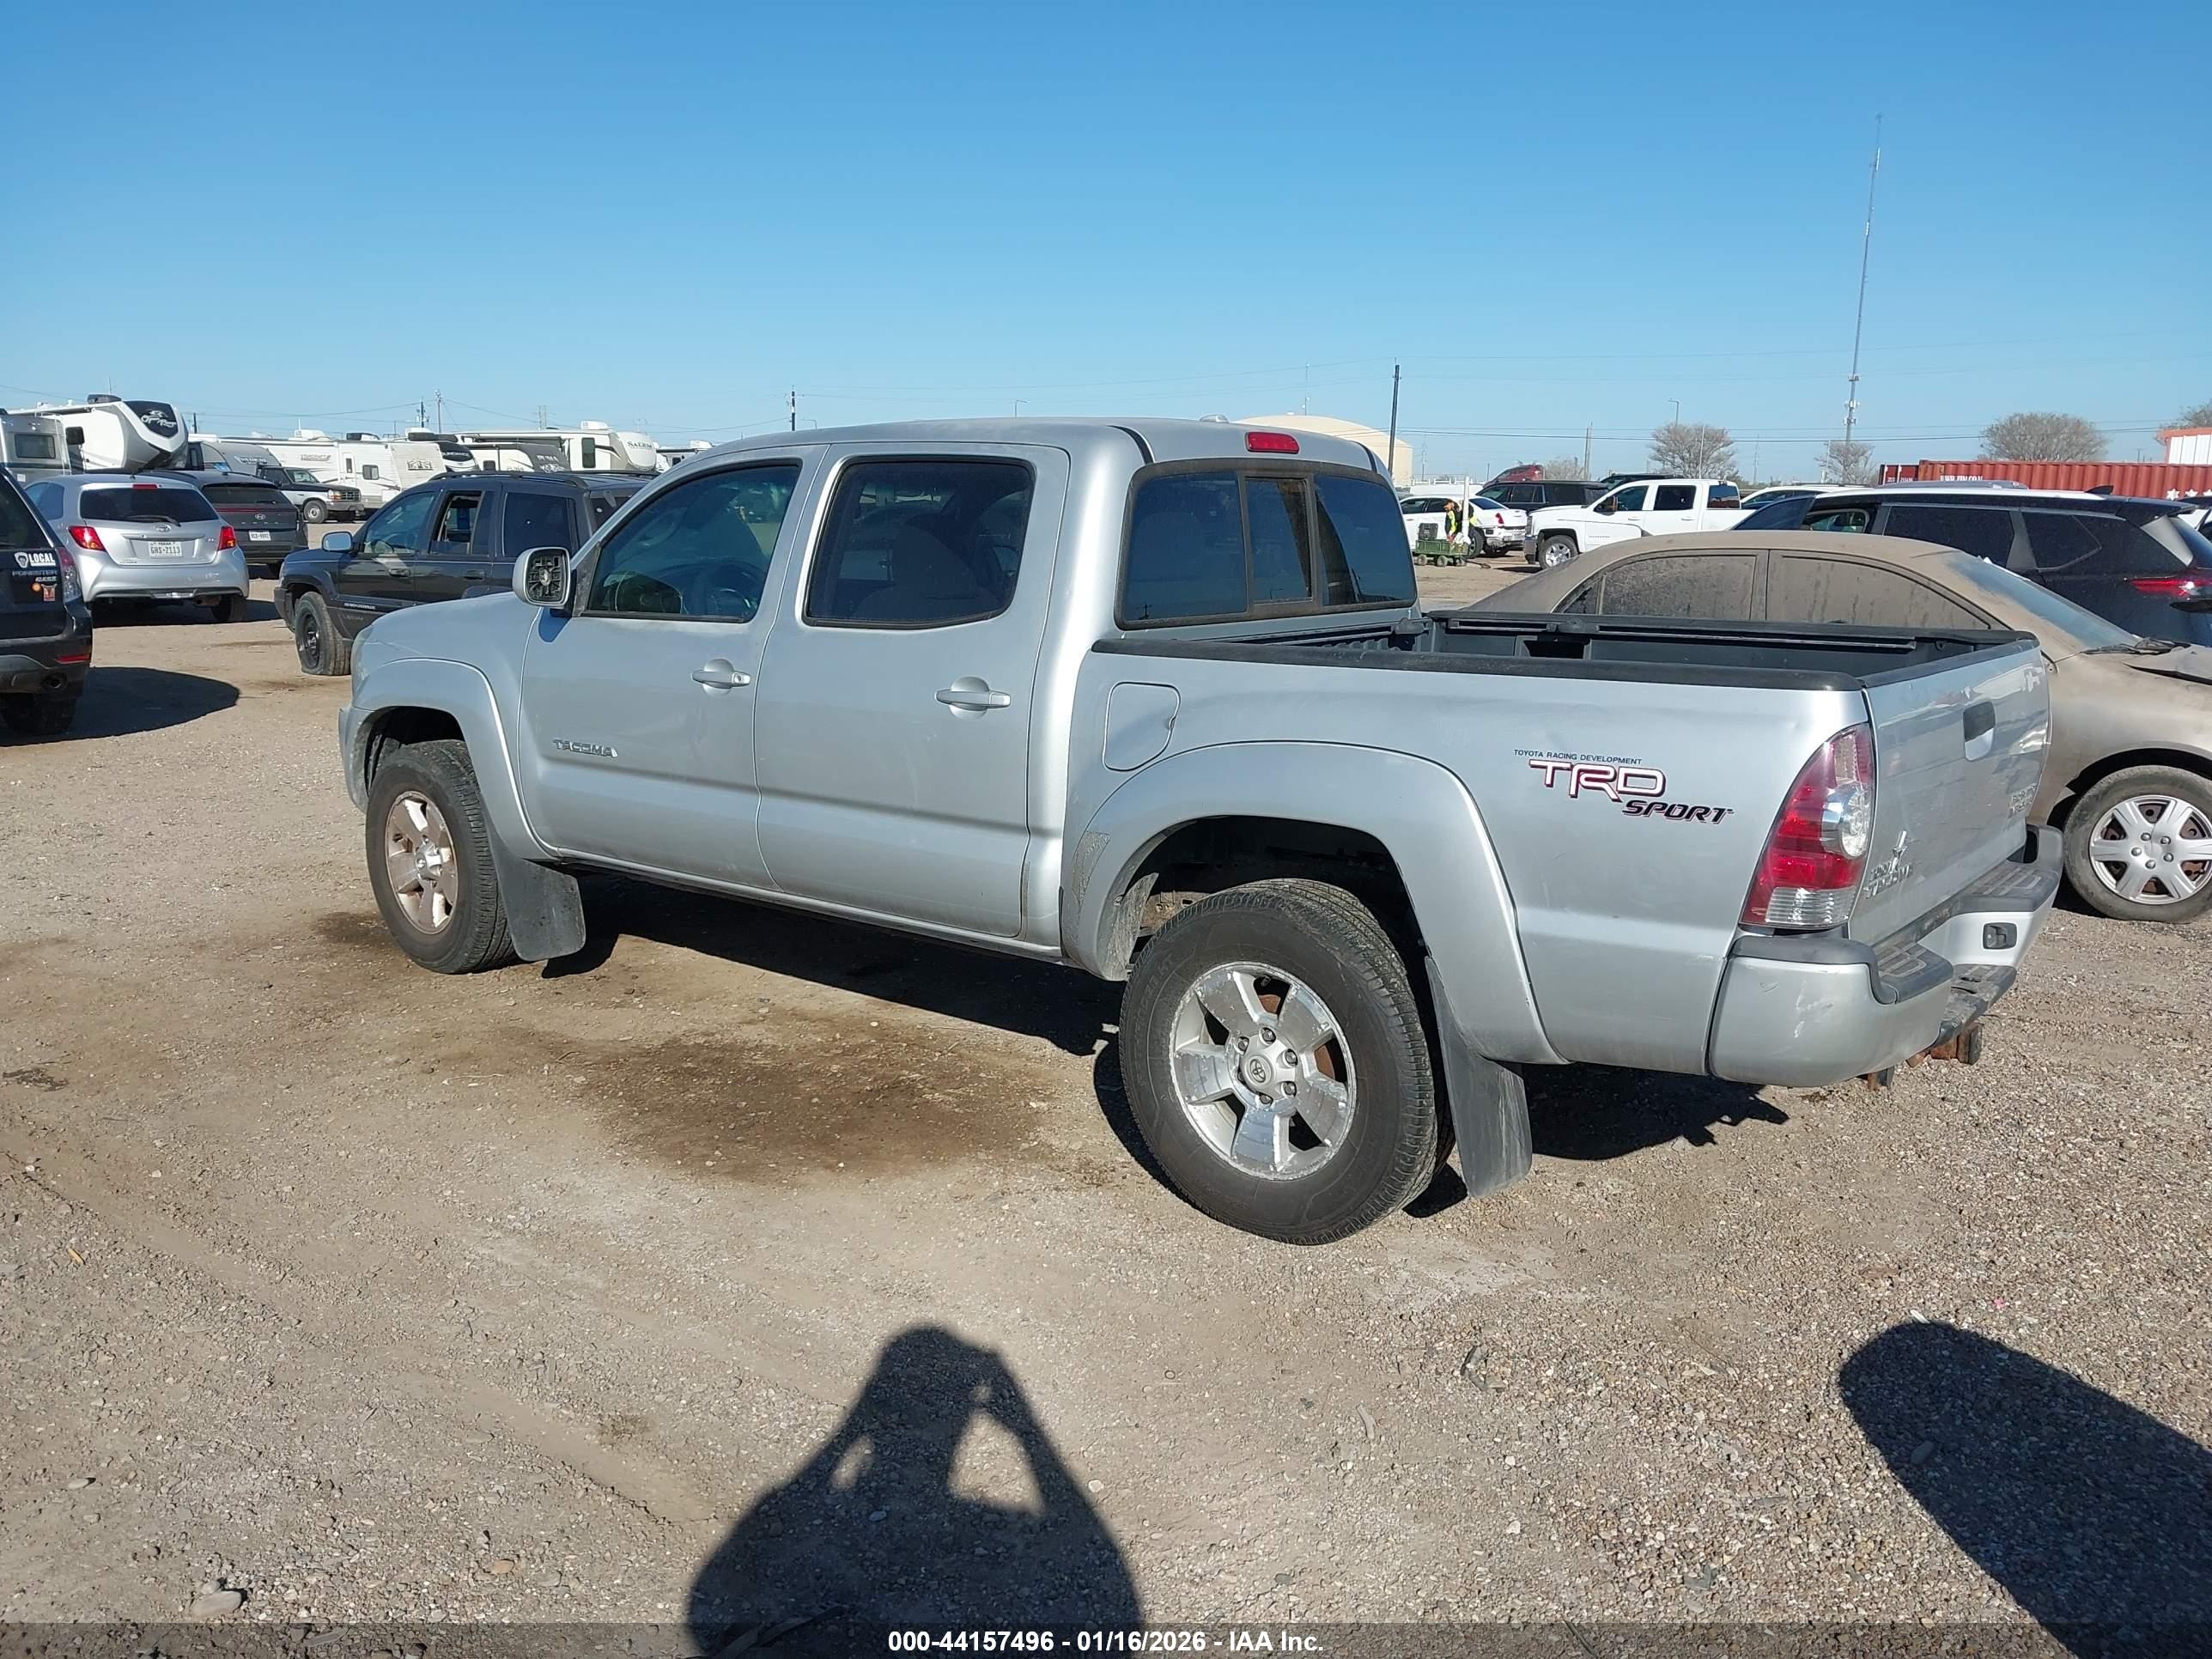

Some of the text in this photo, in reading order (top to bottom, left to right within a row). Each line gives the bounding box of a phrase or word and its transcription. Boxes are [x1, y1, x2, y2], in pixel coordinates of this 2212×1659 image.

[28, 552, 56, 563] LOCAL
[552, 738, 618, 757] TACOMA
[1514, 749, 1643, 765] TOYOTA RACING DEVELOPMENT
[1528, 758, 1667, 803] TRD
[1622, 799, 1734, 825] SPORT
